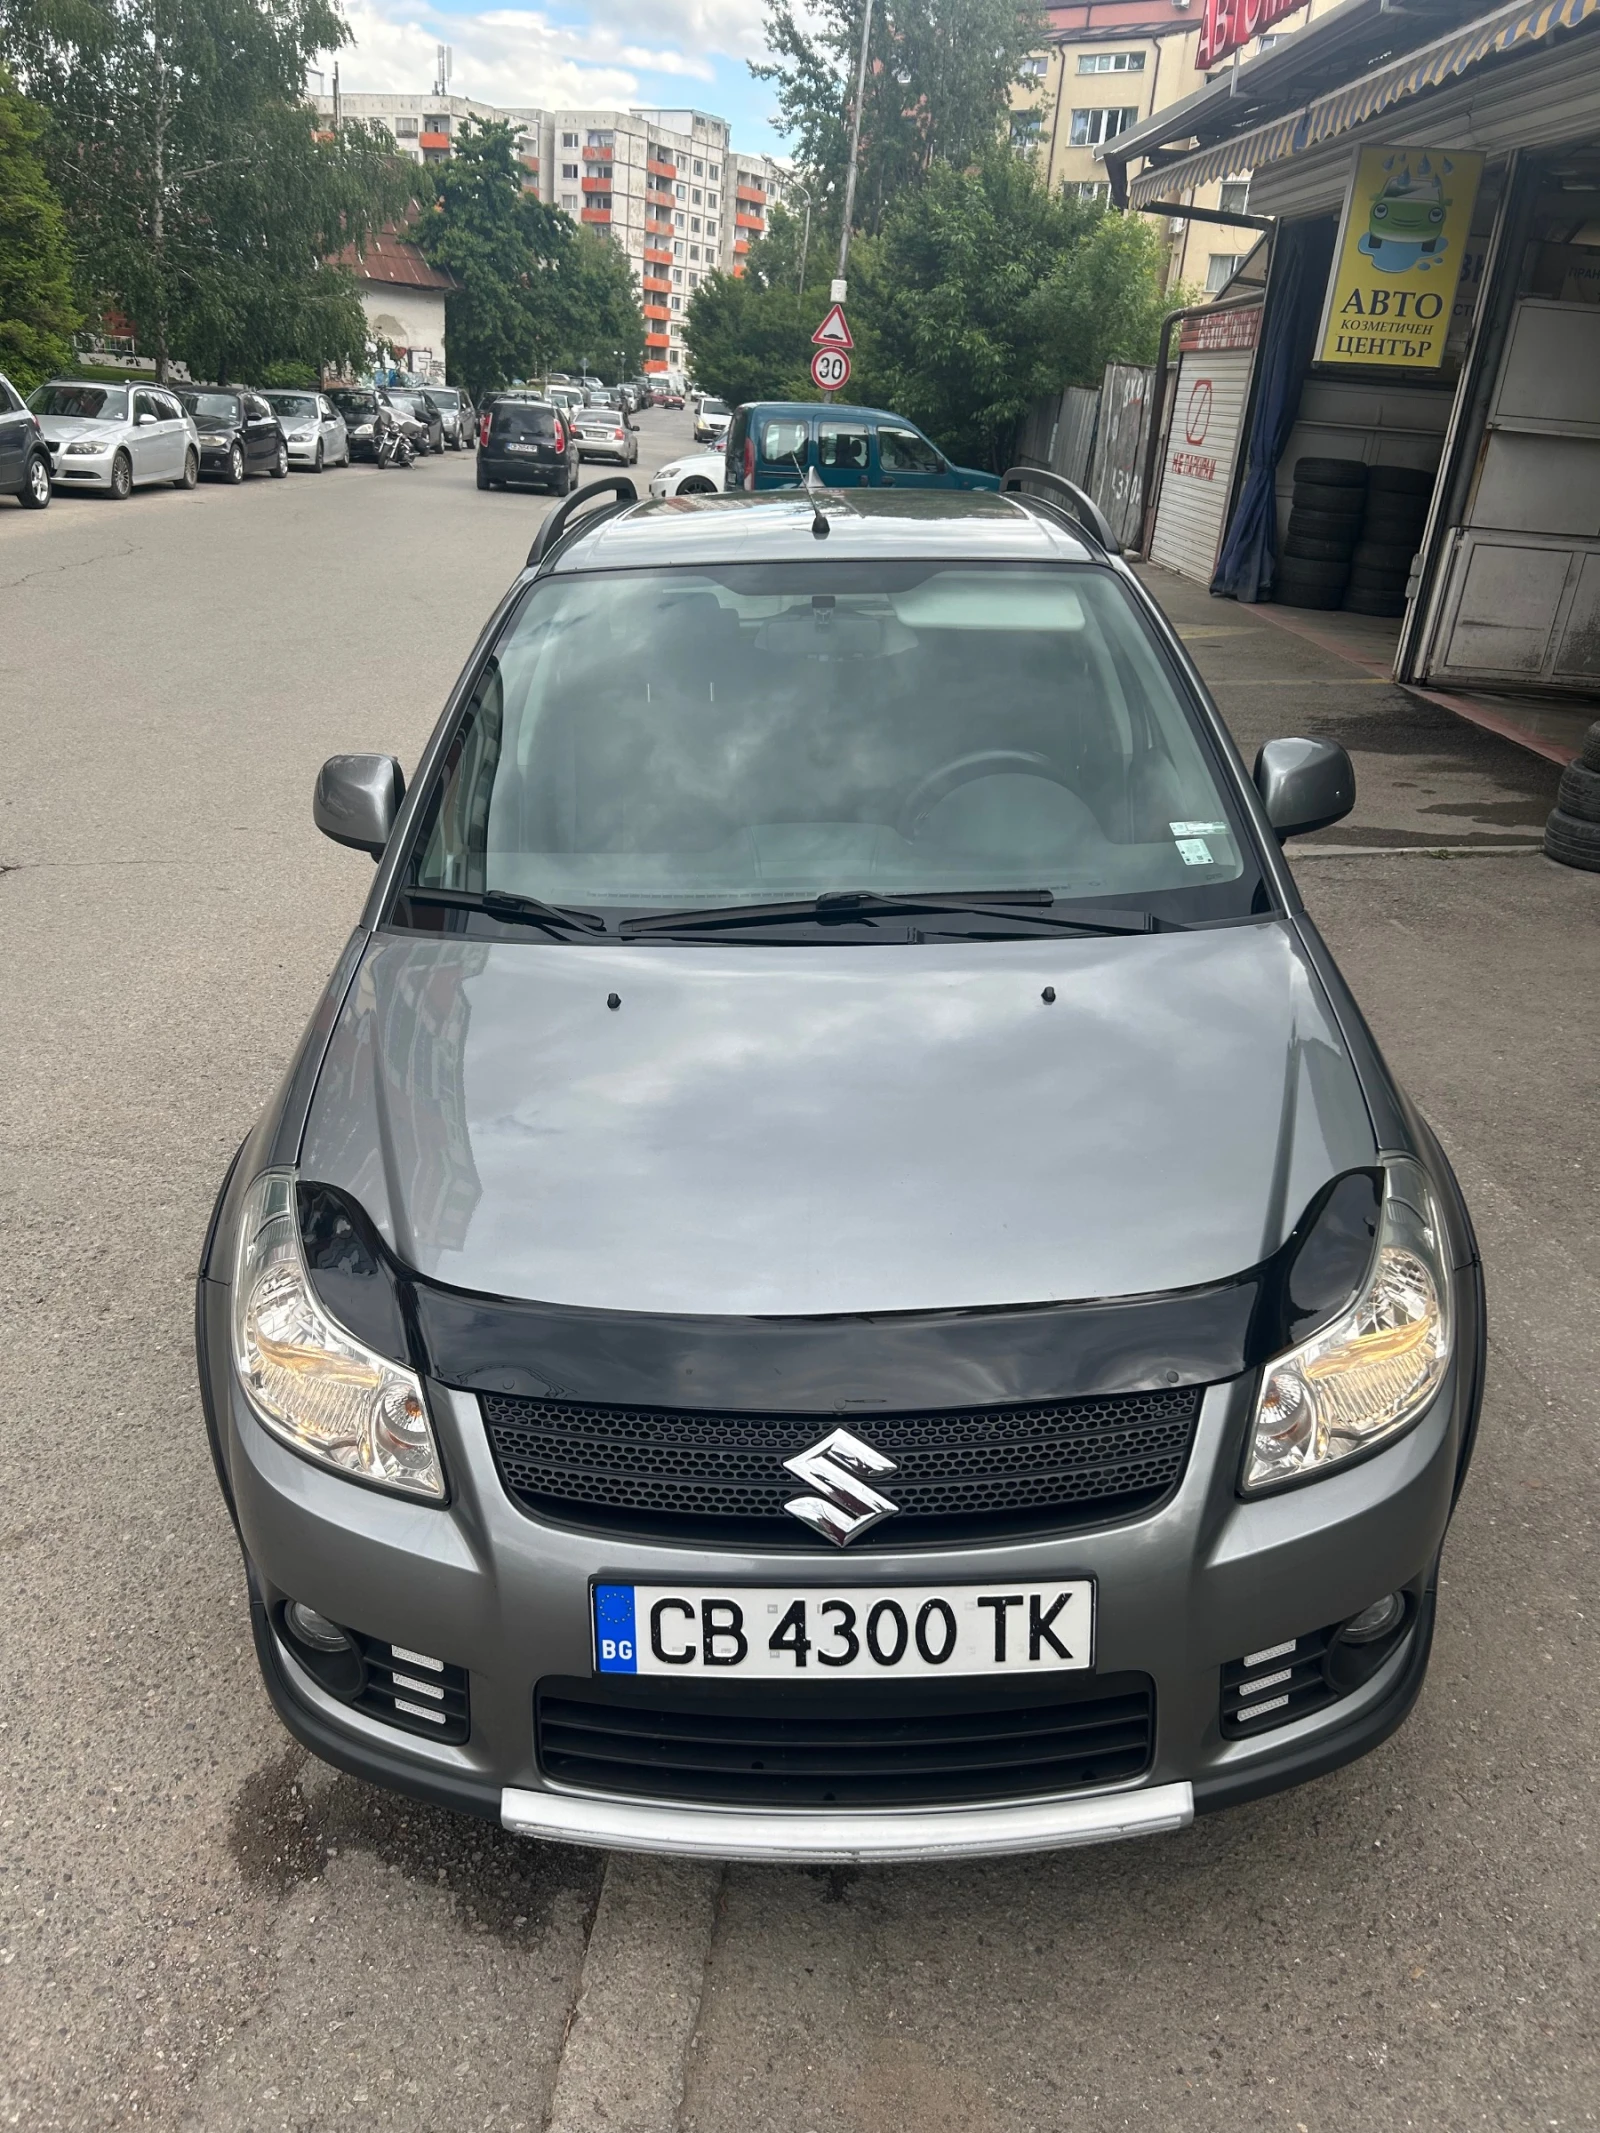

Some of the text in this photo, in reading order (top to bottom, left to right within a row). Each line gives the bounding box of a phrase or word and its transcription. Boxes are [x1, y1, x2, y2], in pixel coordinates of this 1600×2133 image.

[1340, 288, 1443, 319] АВТО
[1340, 319, 1434, 335] КОЗМЕТИЧЕН
[1335, 335, 1432, 358] ЦЕНТЪР
[819, 357, 843, 380] 30
[650, 1592, 1074, 1667] CB 4300 TK
[601, 1640, 633, 1660] BG
